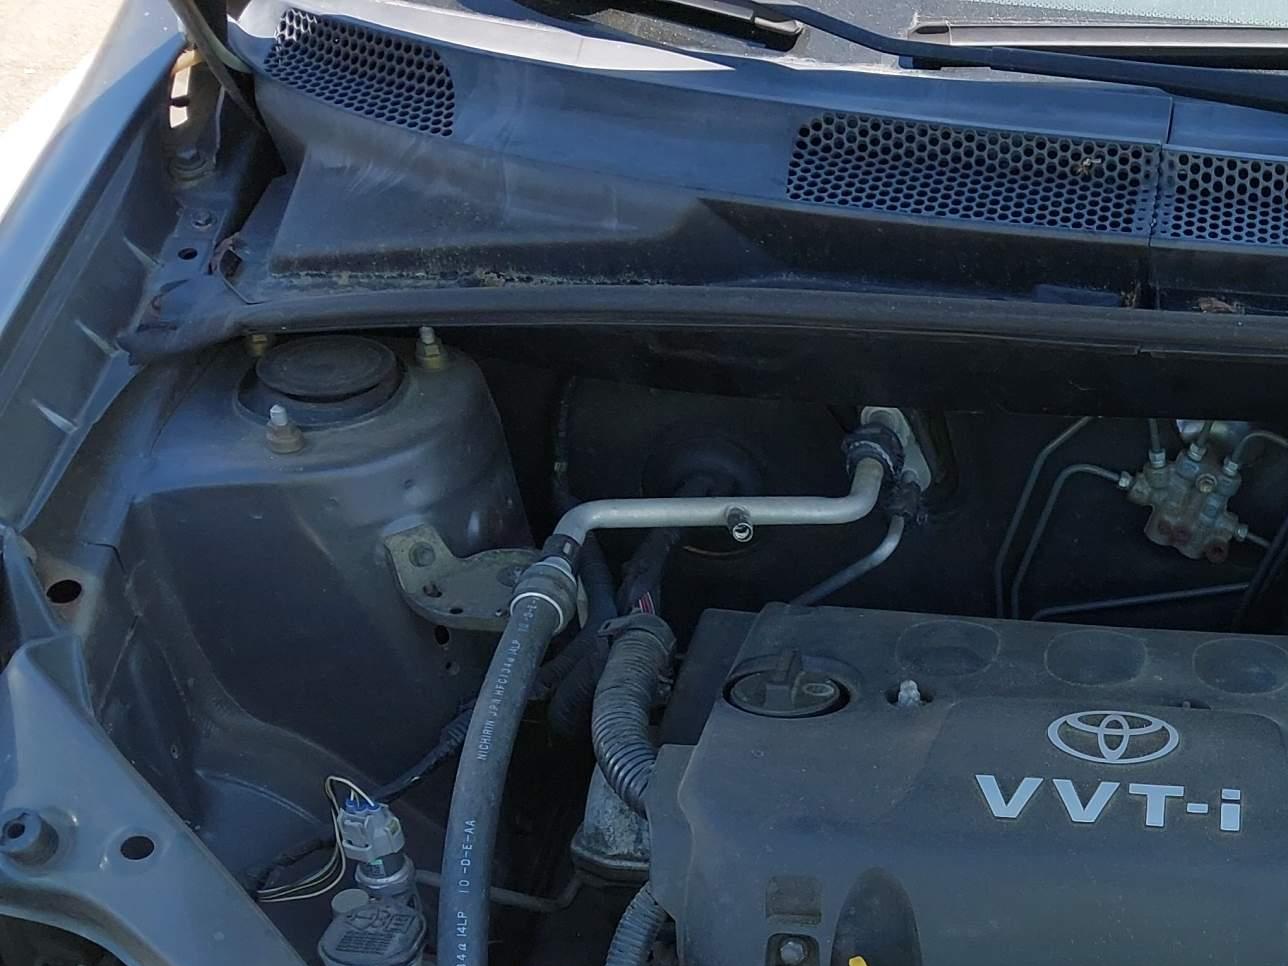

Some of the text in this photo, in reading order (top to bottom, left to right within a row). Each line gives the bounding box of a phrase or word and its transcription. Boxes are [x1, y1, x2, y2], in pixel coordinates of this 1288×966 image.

[476, 720, 494, 760] NICHIRIN
[976, 774, 1241, 831] VVT-i
[457, 911, 468, 937] 14LP
